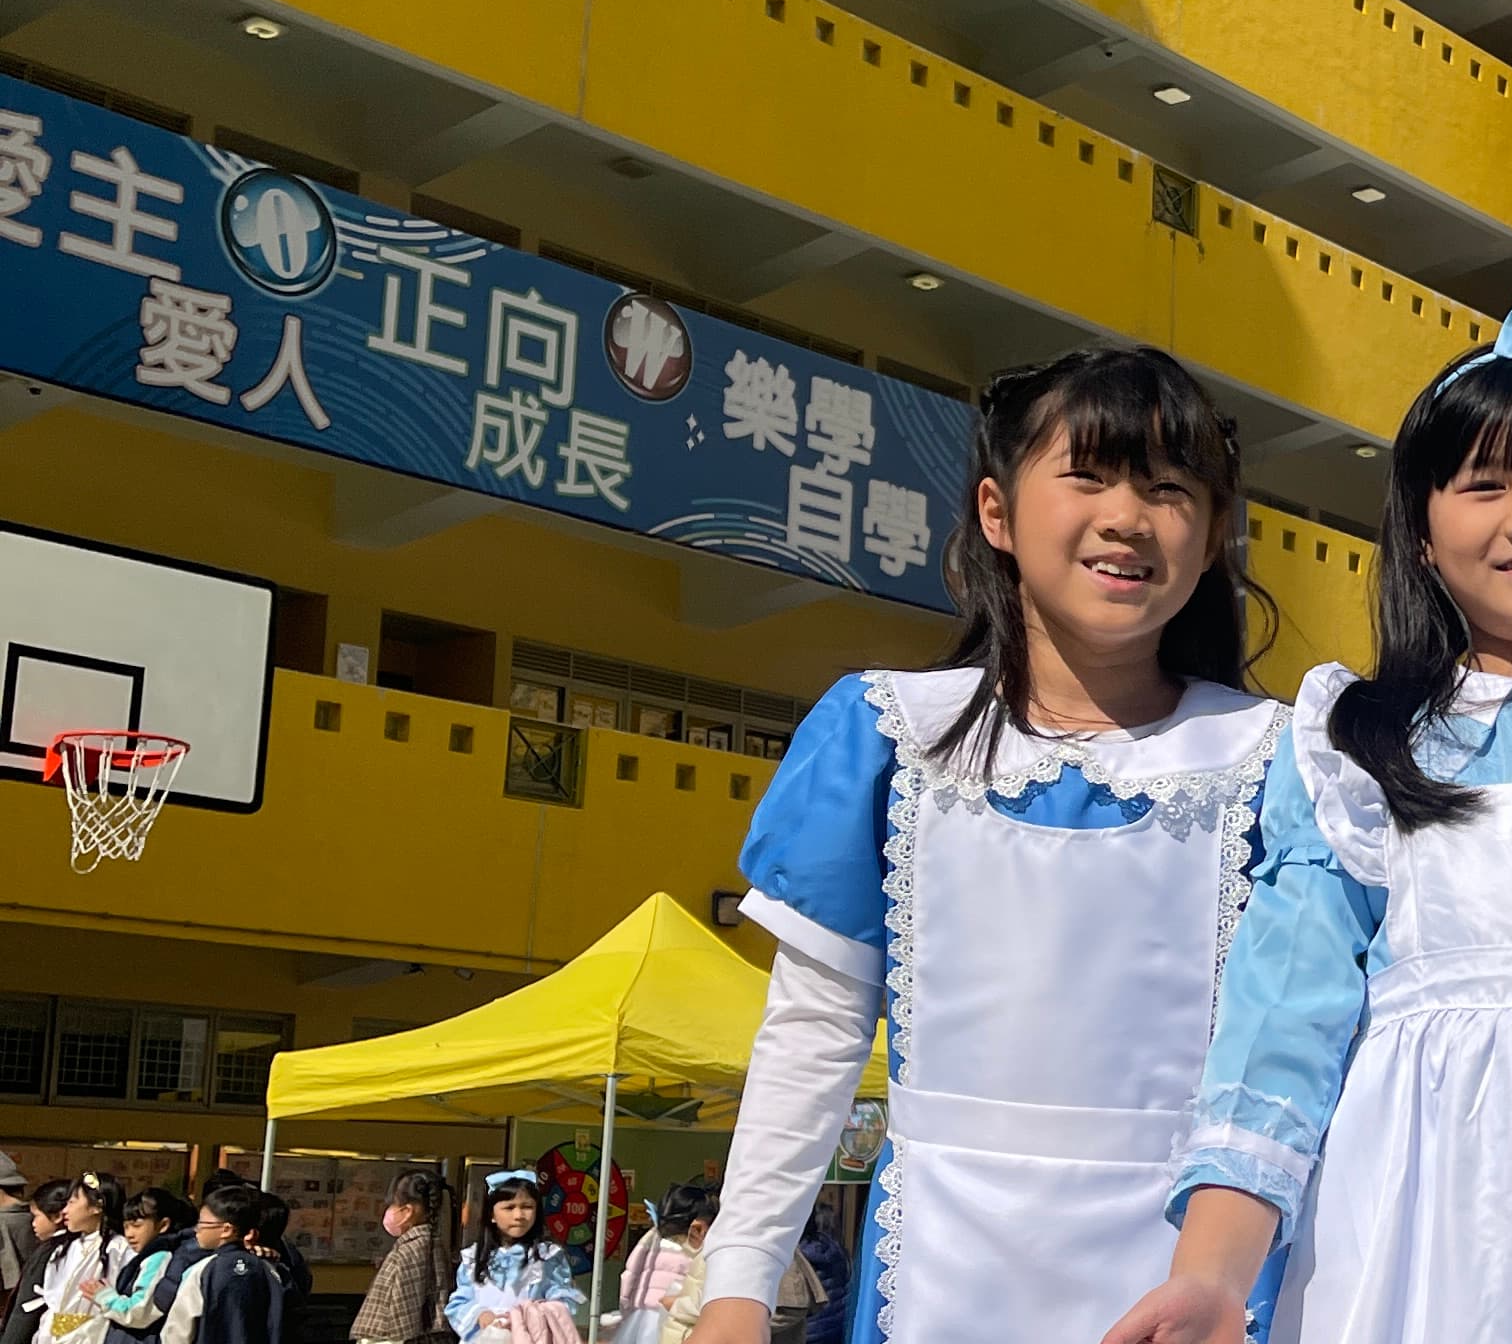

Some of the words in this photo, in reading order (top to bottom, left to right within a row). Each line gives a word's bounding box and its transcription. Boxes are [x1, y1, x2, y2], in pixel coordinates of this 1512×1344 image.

[136, 277, 332, 431] 愛人
[368, 243, 578, 408] 正向
[464, 386, 633, 511] 成長
[722, 348, 876, 476] 樂學
[786, 461, 931, 578] 自學
[565, 1202, 586, 1215] 100
